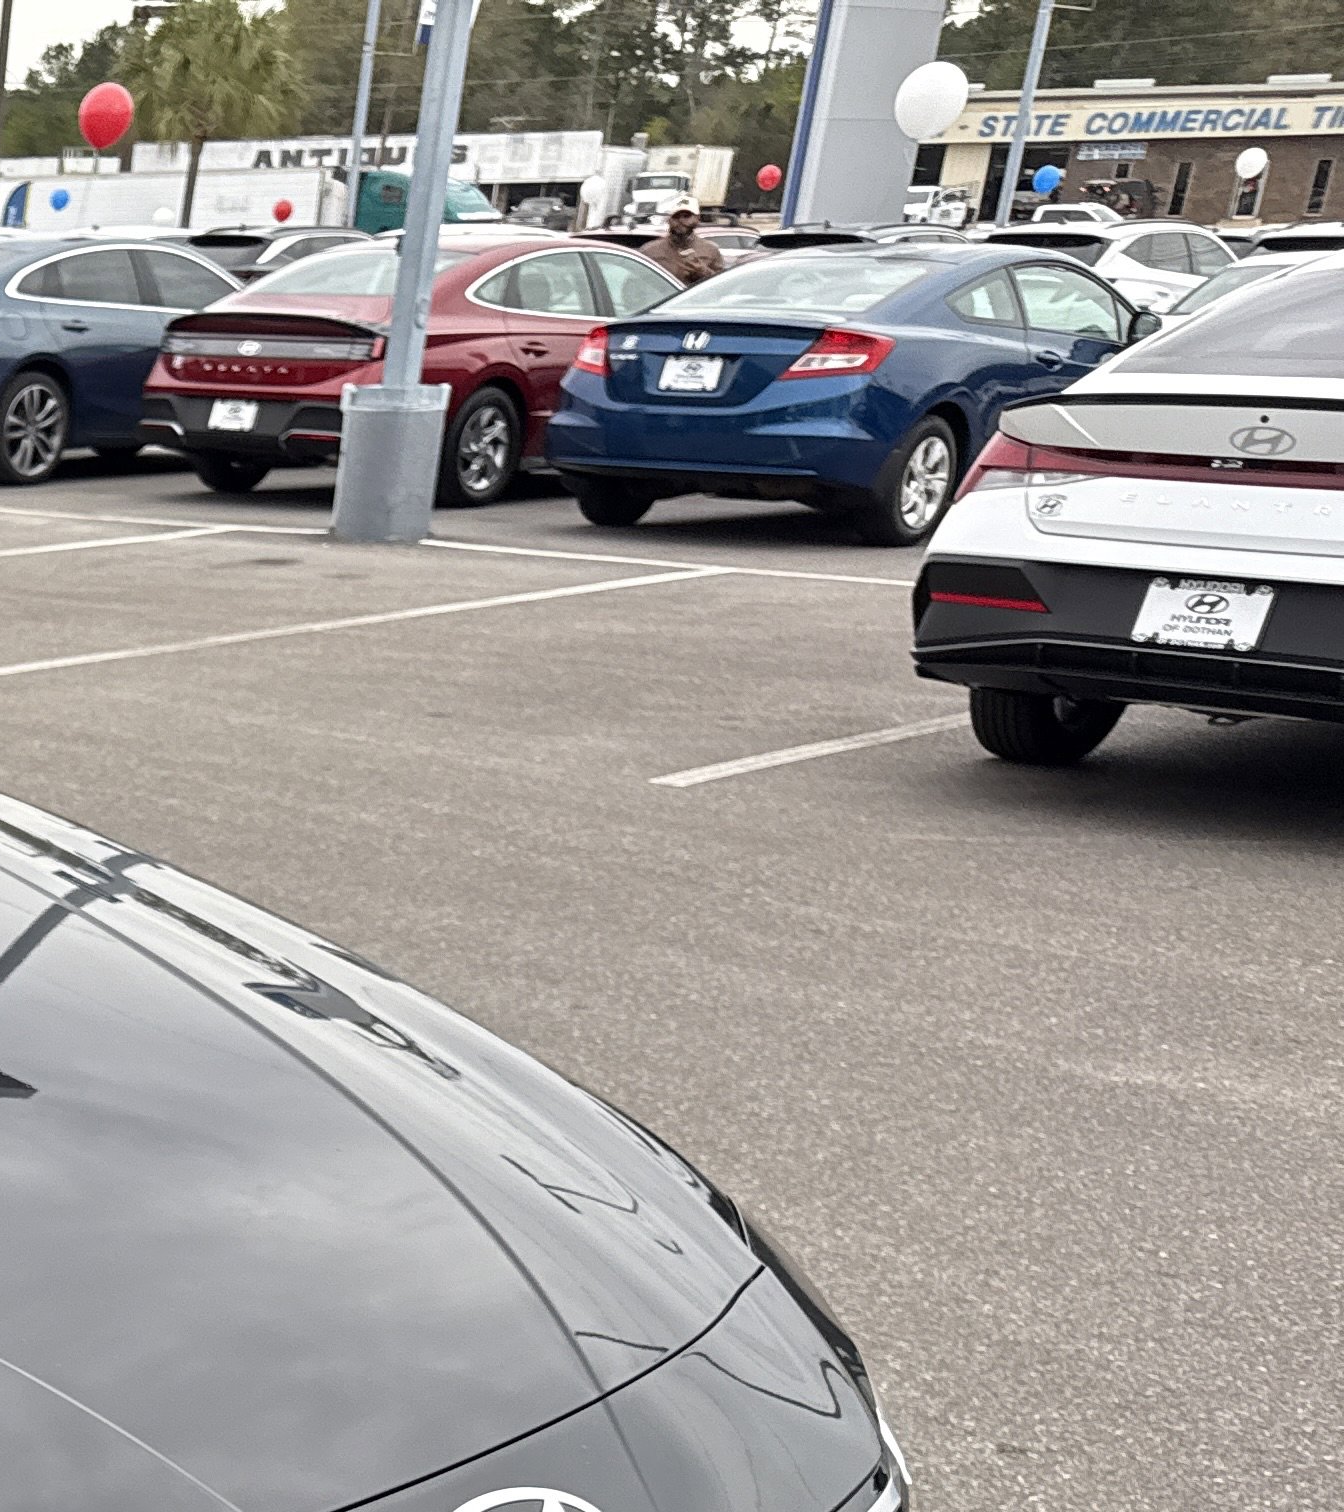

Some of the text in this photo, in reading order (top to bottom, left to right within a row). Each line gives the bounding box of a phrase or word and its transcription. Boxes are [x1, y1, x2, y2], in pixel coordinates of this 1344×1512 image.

[978, 114, 1071, 138] STTE
[1085, 107, 1290, 136] COMMERCIAL
[252, 144, 468, 169] ANTIQUS
[1162, 623, 1233, 636] OF DOTHAN
[1170, 614, 1233, 626] HYUNDAI
